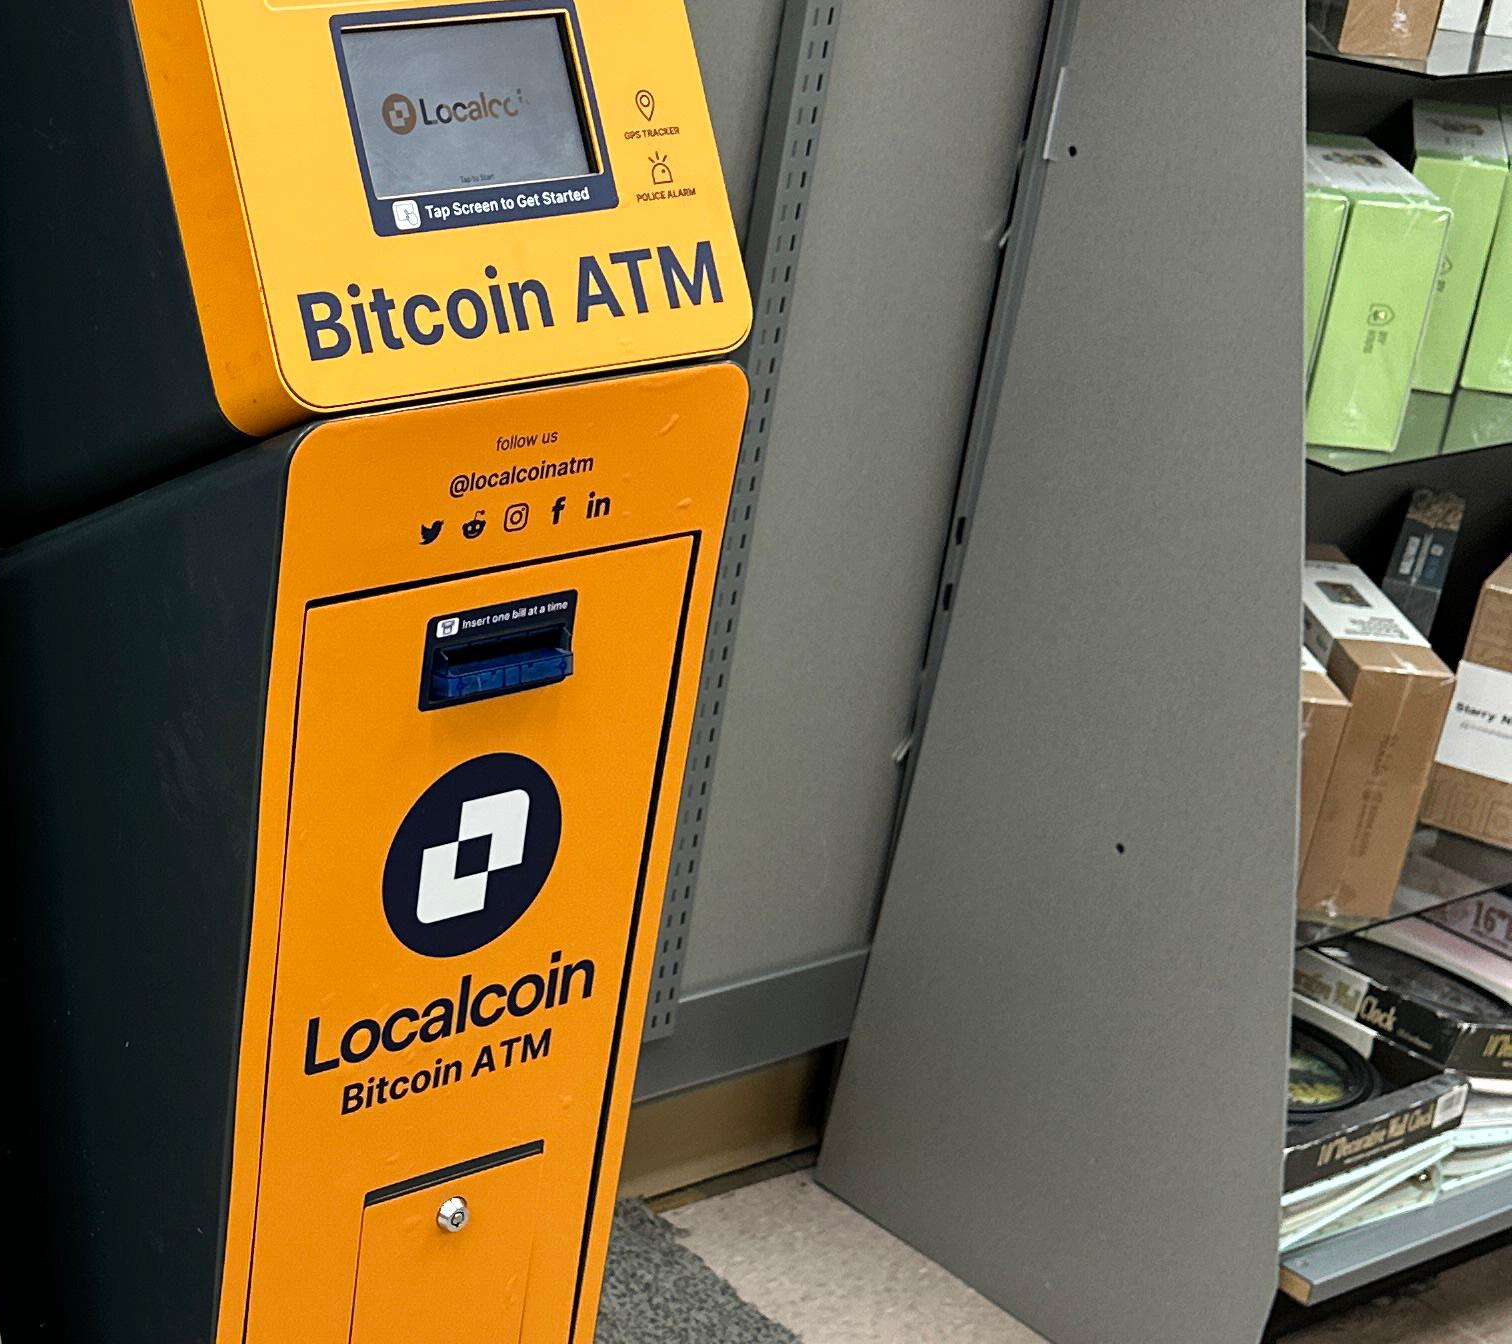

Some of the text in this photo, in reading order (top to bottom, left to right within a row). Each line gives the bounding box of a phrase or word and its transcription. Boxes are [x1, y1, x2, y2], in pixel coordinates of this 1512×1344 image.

[624, 126, 680, 140] GPS TRACKER
[425, 187, 590, 221] Tap Screen to Get Started
[637, 188, 696, 202] POLICE ALARM
[297, 241, 724, 361] Bitcoin ATM
[495, 430, 558, 452] follow us
[449, 455, 594, 498] @localcoinatm
[462, 616, 490, 630] Insert
[492, 614, 510, 624] one
[512, 608, 527, 620] bill
[528, 606, 537, 617] at
[547, 602, 568, 613] time
[303, 950, 595, 1076] Localcoin
[341, 1028, 552, 1115] Bitcoin ATM
